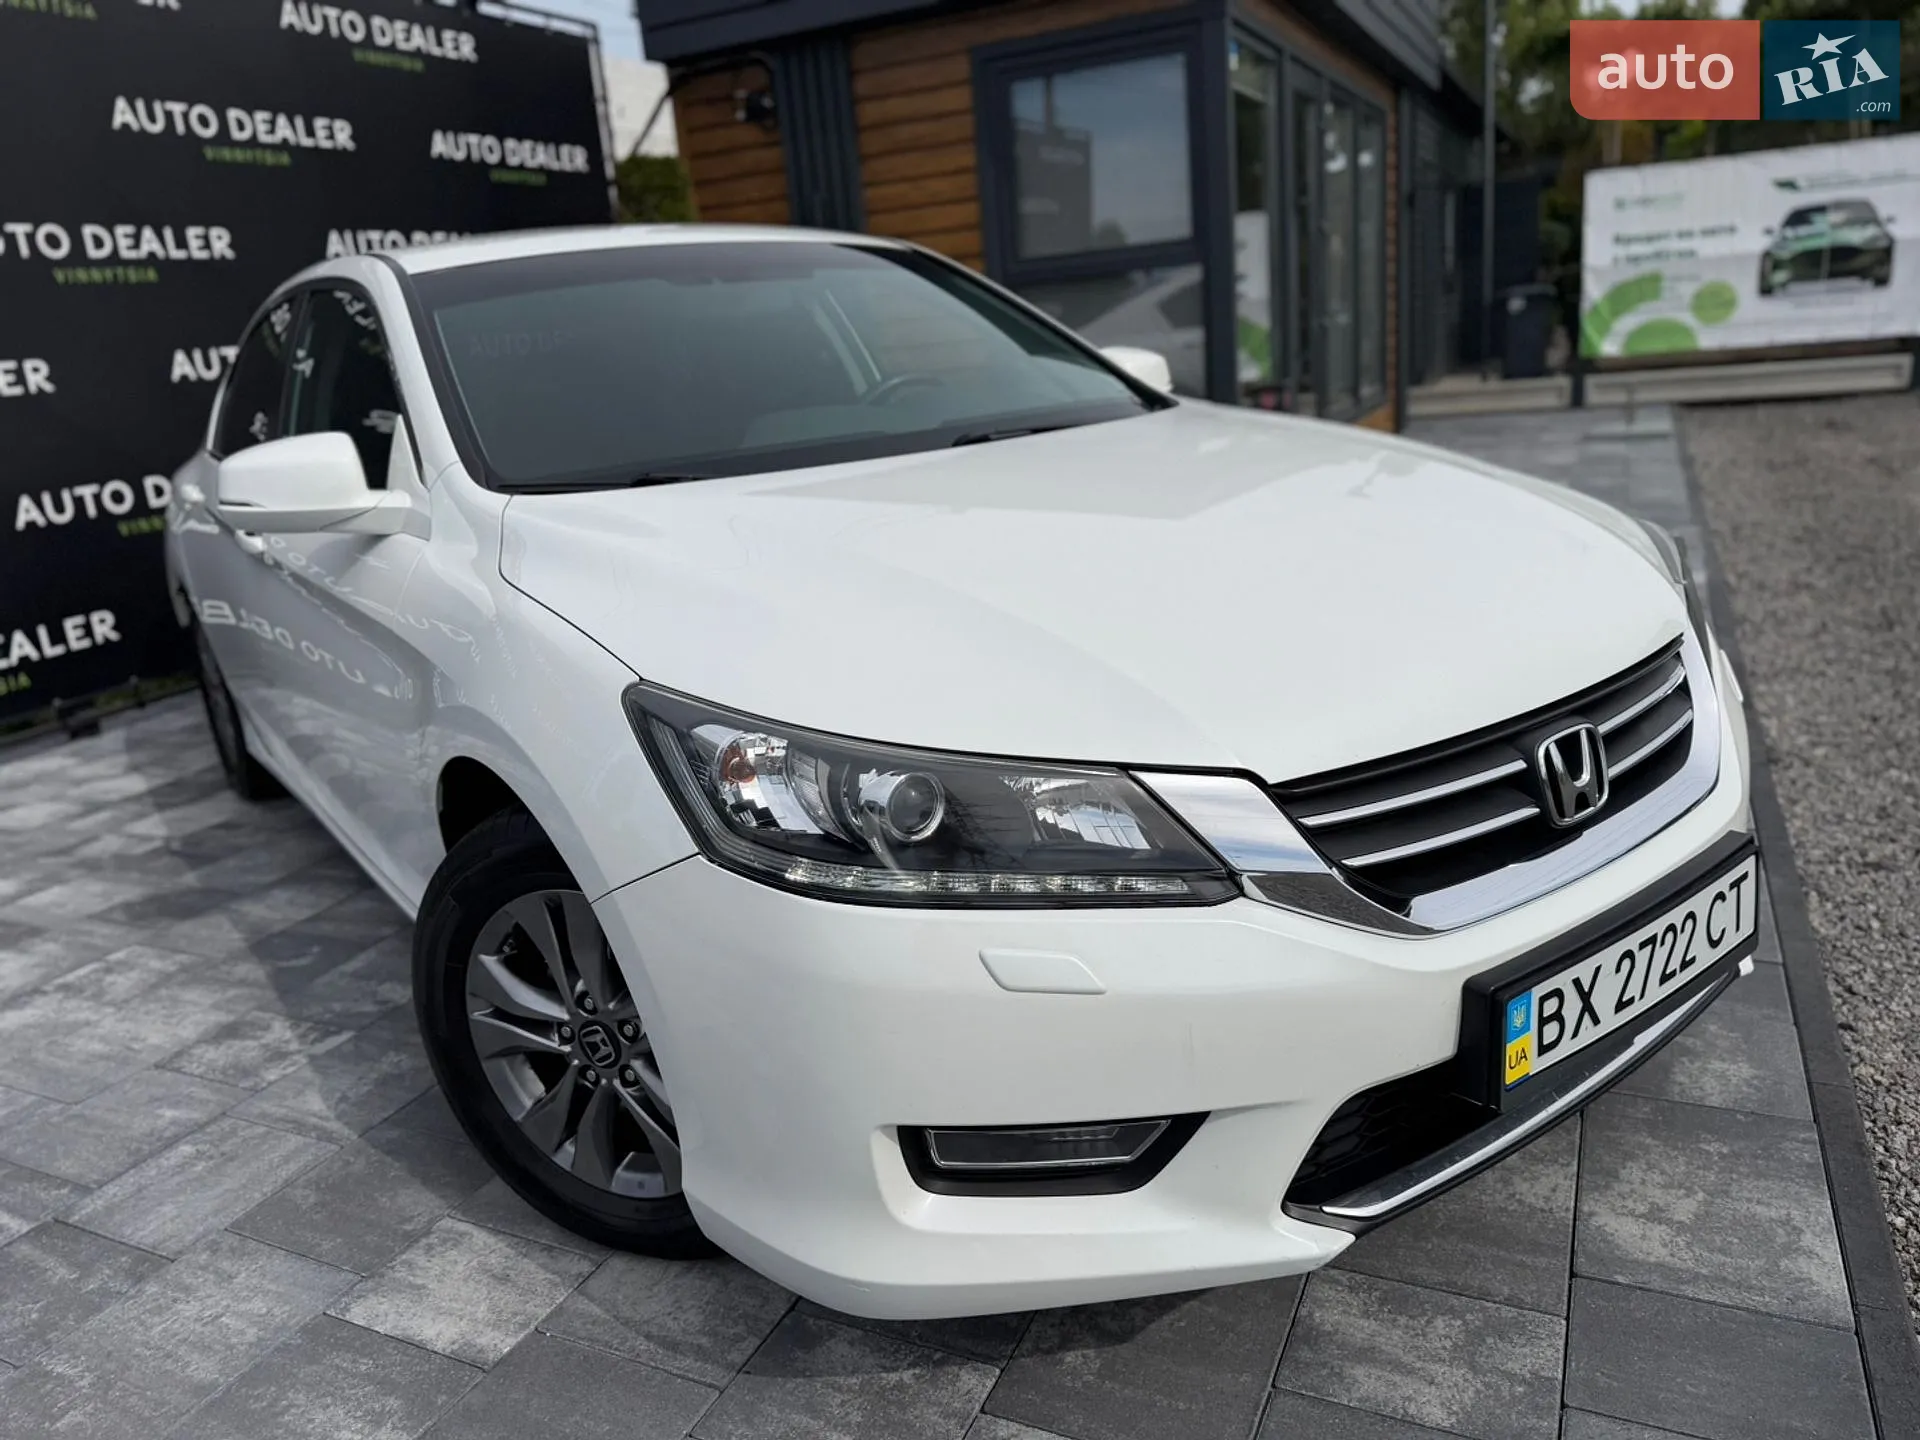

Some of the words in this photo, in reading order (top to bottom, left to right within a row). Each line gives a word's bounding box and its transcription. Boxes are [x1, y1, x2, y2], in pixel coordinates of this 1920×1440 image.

[279, 0, 367, 43] AUTO
[369, 14, 479, 63] DEALER
[111, 95, 219, 139] AUTO
[225, 107, 356, 151] DEALER
[430, 129, 501, 165] AUTO
[502, 137, 590, 174] DEALER
[81, 223, 236, 260] DEALER
[15, 480, 135, 531] AUTO
[1537, 964, 1602, 1057] BX
[1613, 910, 1698, 1015] 2722
[1705, 870, 1750, 949] CT
[1508, 1046, 1529, 1070] UA
